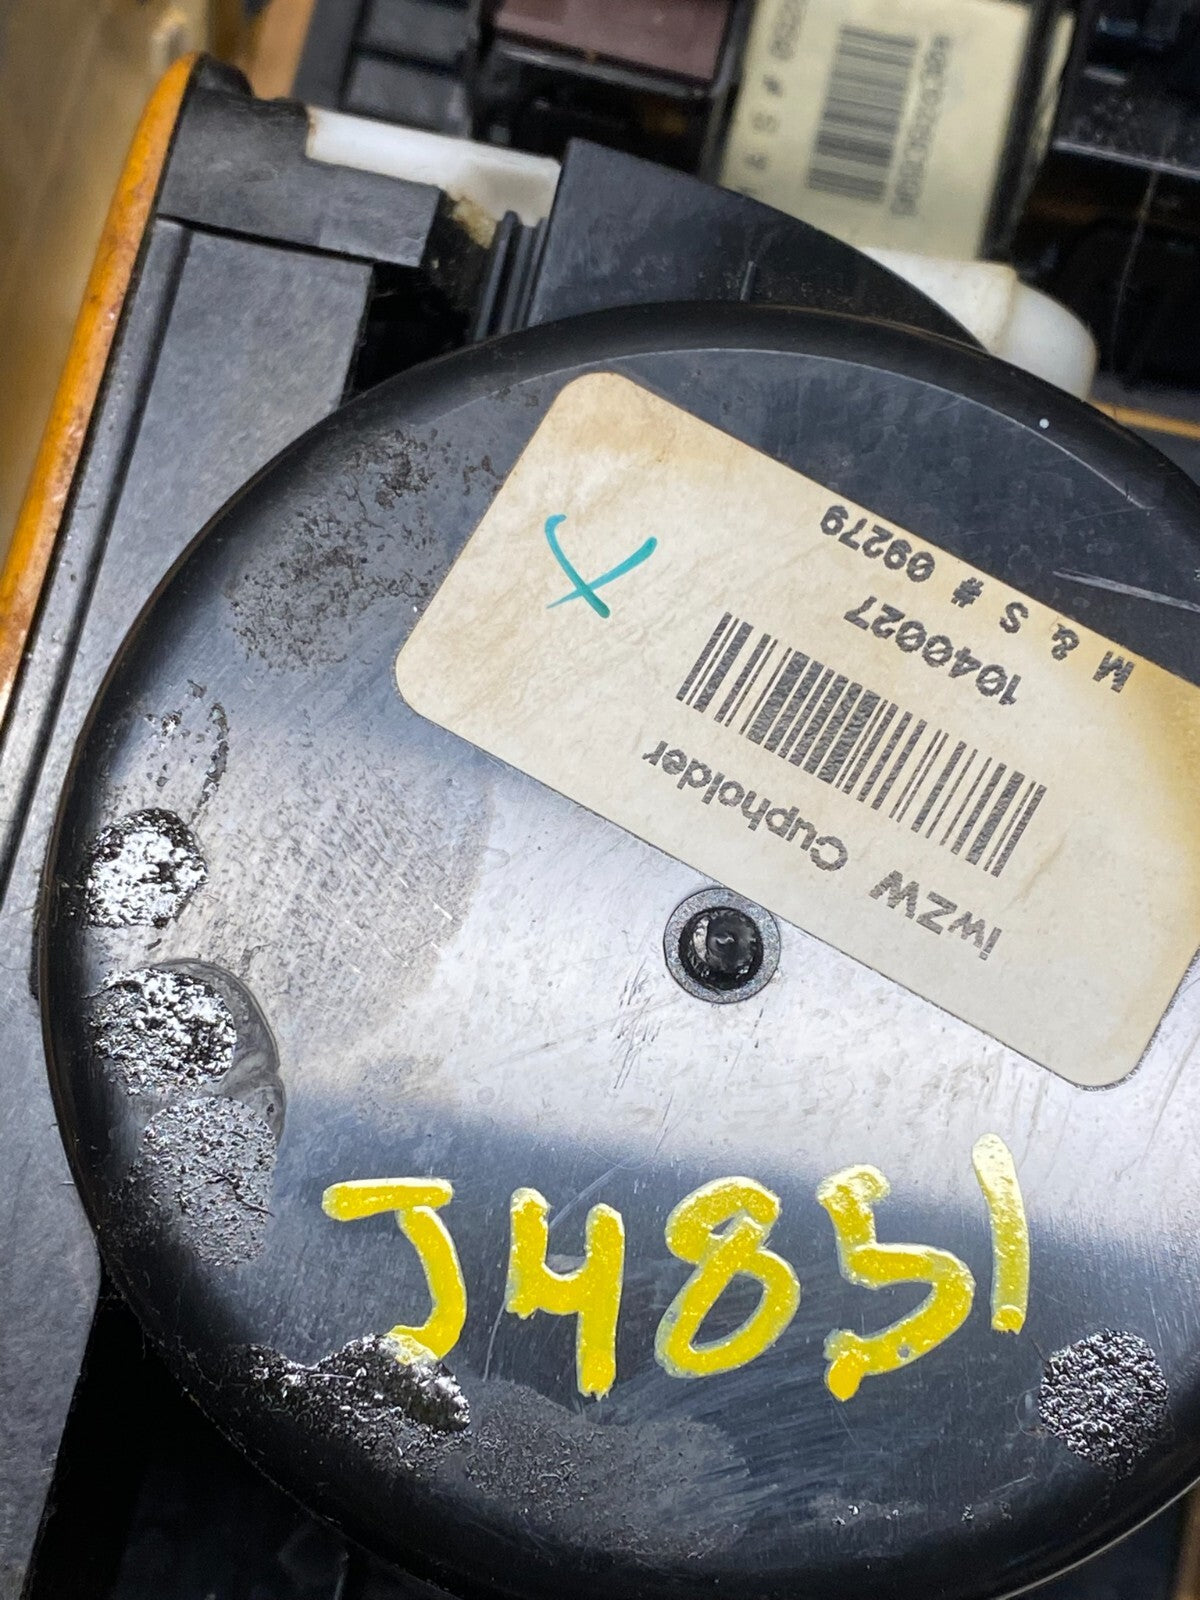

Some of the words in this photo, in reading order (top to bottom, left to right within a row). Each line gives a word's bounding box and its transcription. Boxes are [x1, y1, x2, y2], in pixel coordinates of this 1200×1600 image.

[820, 505, 935, 583] 09279
[951, 576, 985, 608] #
[1000, 602, 1029, 633] S
[843, 595, 1021, 706] 1040027
[1052, 624, 1080, 661] &
[1093, 649, 1136, 693] M
[642, 740, 849, 872] Cupholder
